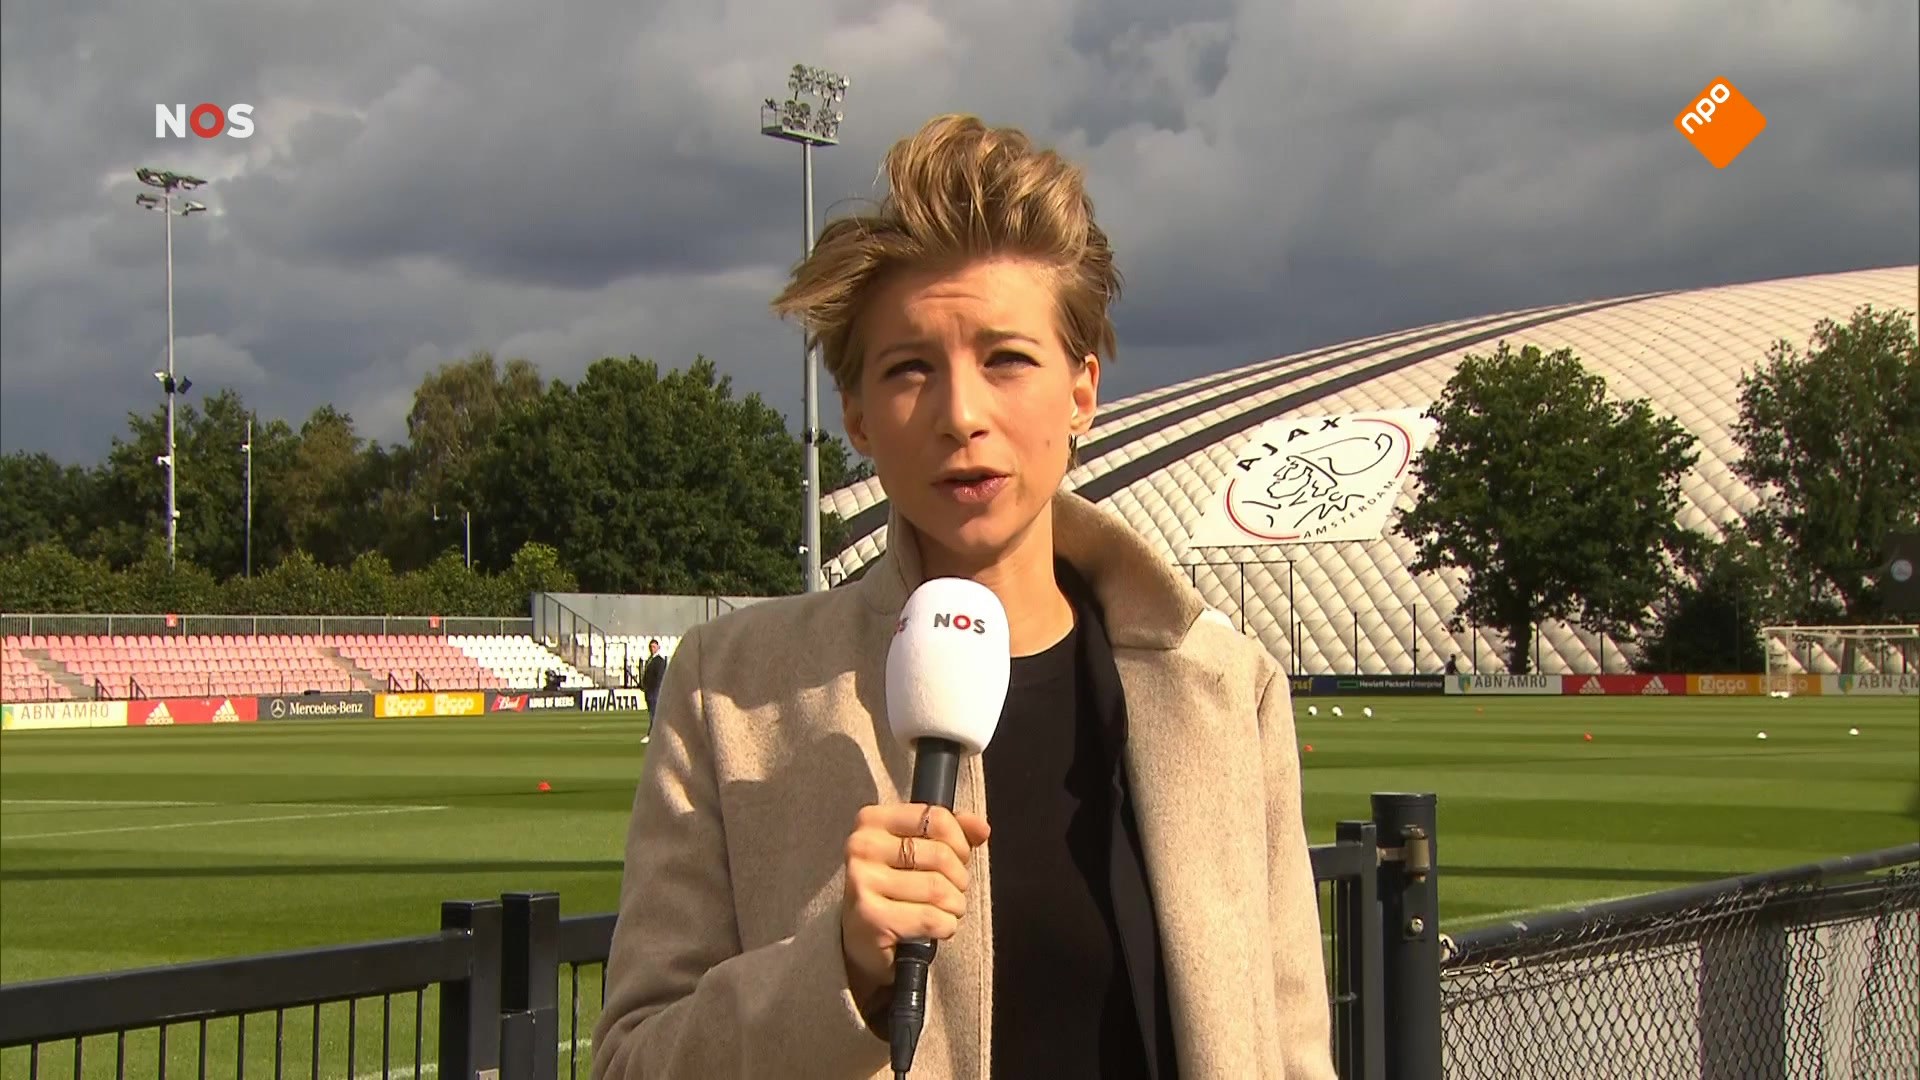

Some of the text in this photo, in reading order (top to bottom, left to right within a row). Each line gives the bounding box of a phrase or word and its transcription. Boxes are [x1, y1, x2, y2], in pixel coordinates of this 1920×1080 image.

[1236, 416, 1342, 472] AJAX
[1303, 479, 1396, 539] AMSTERDAM
[933, 612, 986, 635] NOS
[1359, 680, 1442, 690] Hewlett Packard Enterprise
[289, 700, 364, 716] Mercedes-Benz
[584, 690, 638, 712] LAVAZZA
